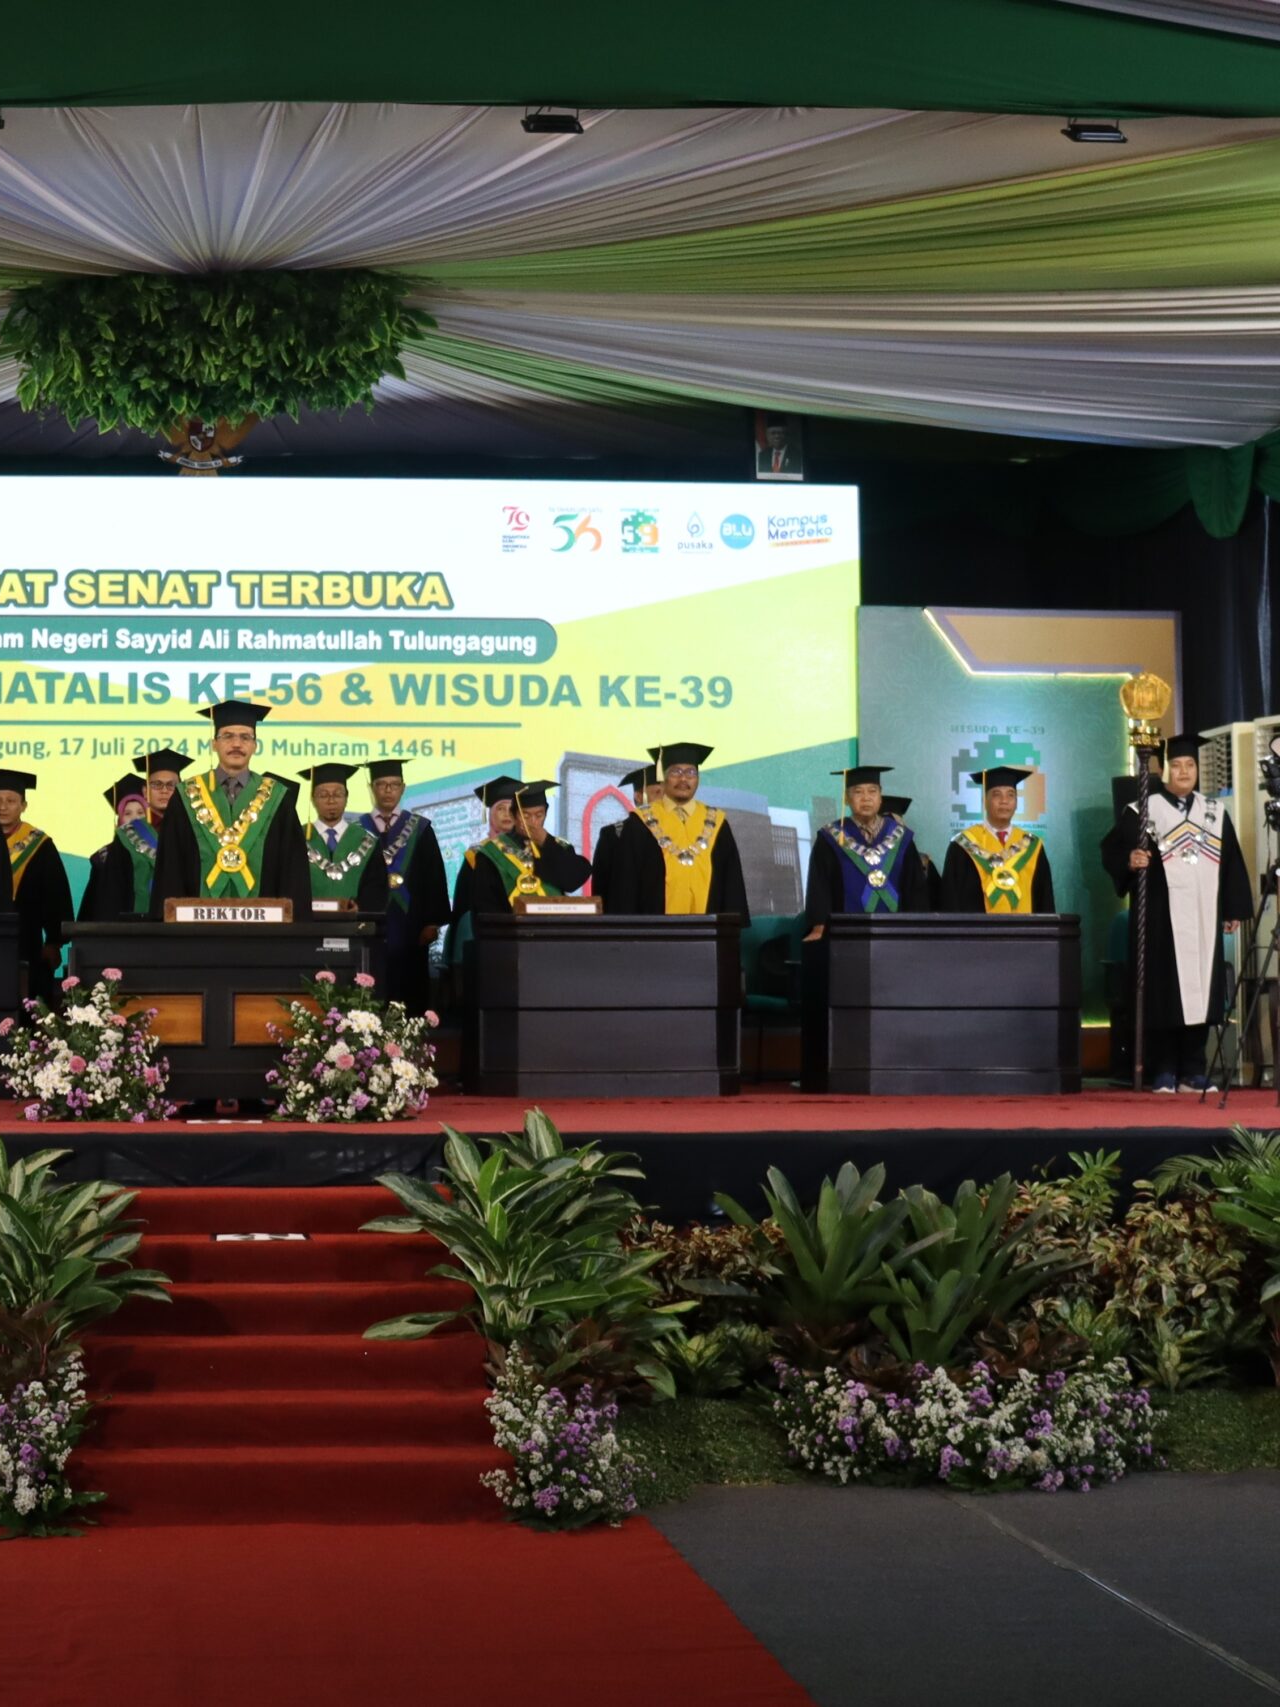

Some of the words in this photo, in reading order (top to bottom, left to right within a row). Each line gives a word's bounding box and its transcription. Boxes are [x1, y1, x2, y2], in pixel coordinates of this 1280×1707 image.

[722, 522, 753, 537] BLU
[768, 514, 828, 530] Kampus
[768, 524, 833, 540] Merdeka
[677, 541, 713, 550] pusaka
[65, 569, 221, 609] SENAT
[228, 570, 454, 610] TERBUKA
[31, 627, 108, 654] Negeri
[115, 628, 192, 654] Sayyid
[198, 629, 230, 650] Ali
[237, 628, 382, 650] Rahmatullah
[389, 629, 537, 656] Tulungagung
[188, 672, 323, 706] KE-56
[340, 672, 373, 706] &
[389, 673, 582, 707] WISUDA
[598, 675, 733, 708] KE-39
[59, 738, 84, 755] 17
[91, 738, 125, 759] Juli
[132, 738, 189, 756] 2024
[272, 739, 369, 757] Muharam
[377, 740, 433, 757] 1446
[441, 740, 456, 757] H
[193, 908, 266, 920] REKTOR
